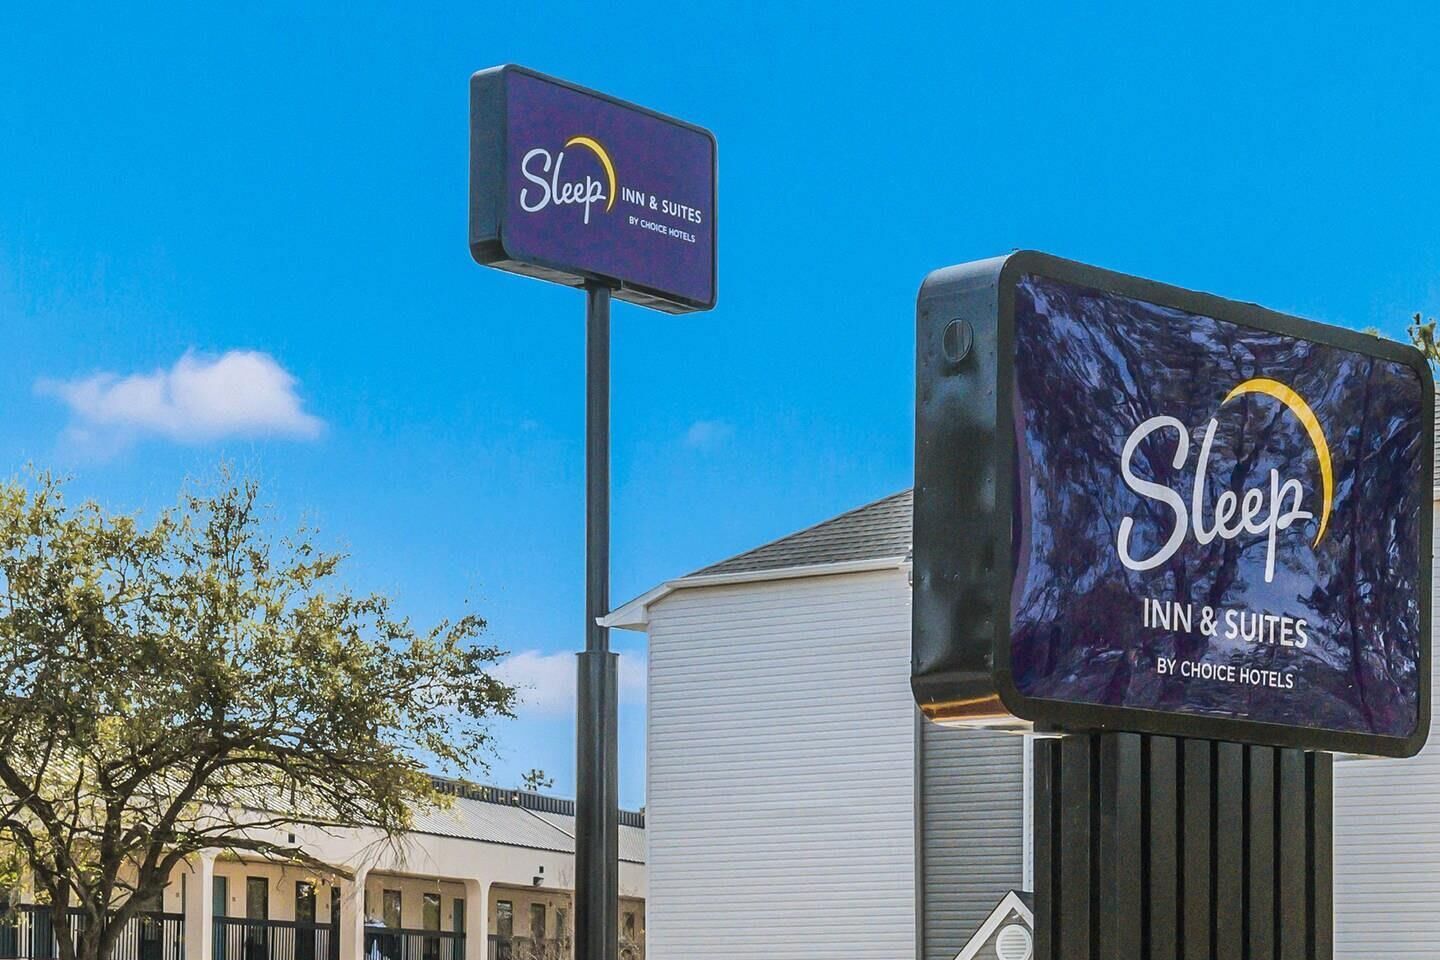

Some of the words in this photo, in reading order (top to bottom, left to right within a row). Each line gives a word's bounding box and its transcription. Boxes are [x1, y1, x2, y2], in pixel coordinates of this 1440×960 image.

[519, 148, 606, 225] Sleep
[622, 187, 645, 207] INN
[649, 196, 658, 211] &
[662, 200, 702, 224] SUITES
[629, 216, 639, 226] BY
[640, 219, 667, 235] CHOICE
[669, 228, 696, 243] HOTELS
[1117, 415, 1313, 583] Sleep
[1143, 597, 1192, 633] INN
[1200, 605, 1218, 637] &
[1225, 608, 1309, 649] SUITES
[1157, 658, 1177, 675] BY
[1180, 660, 1235, 683] CHOICE
[1240, 667, 1294, 689] HOTELS
